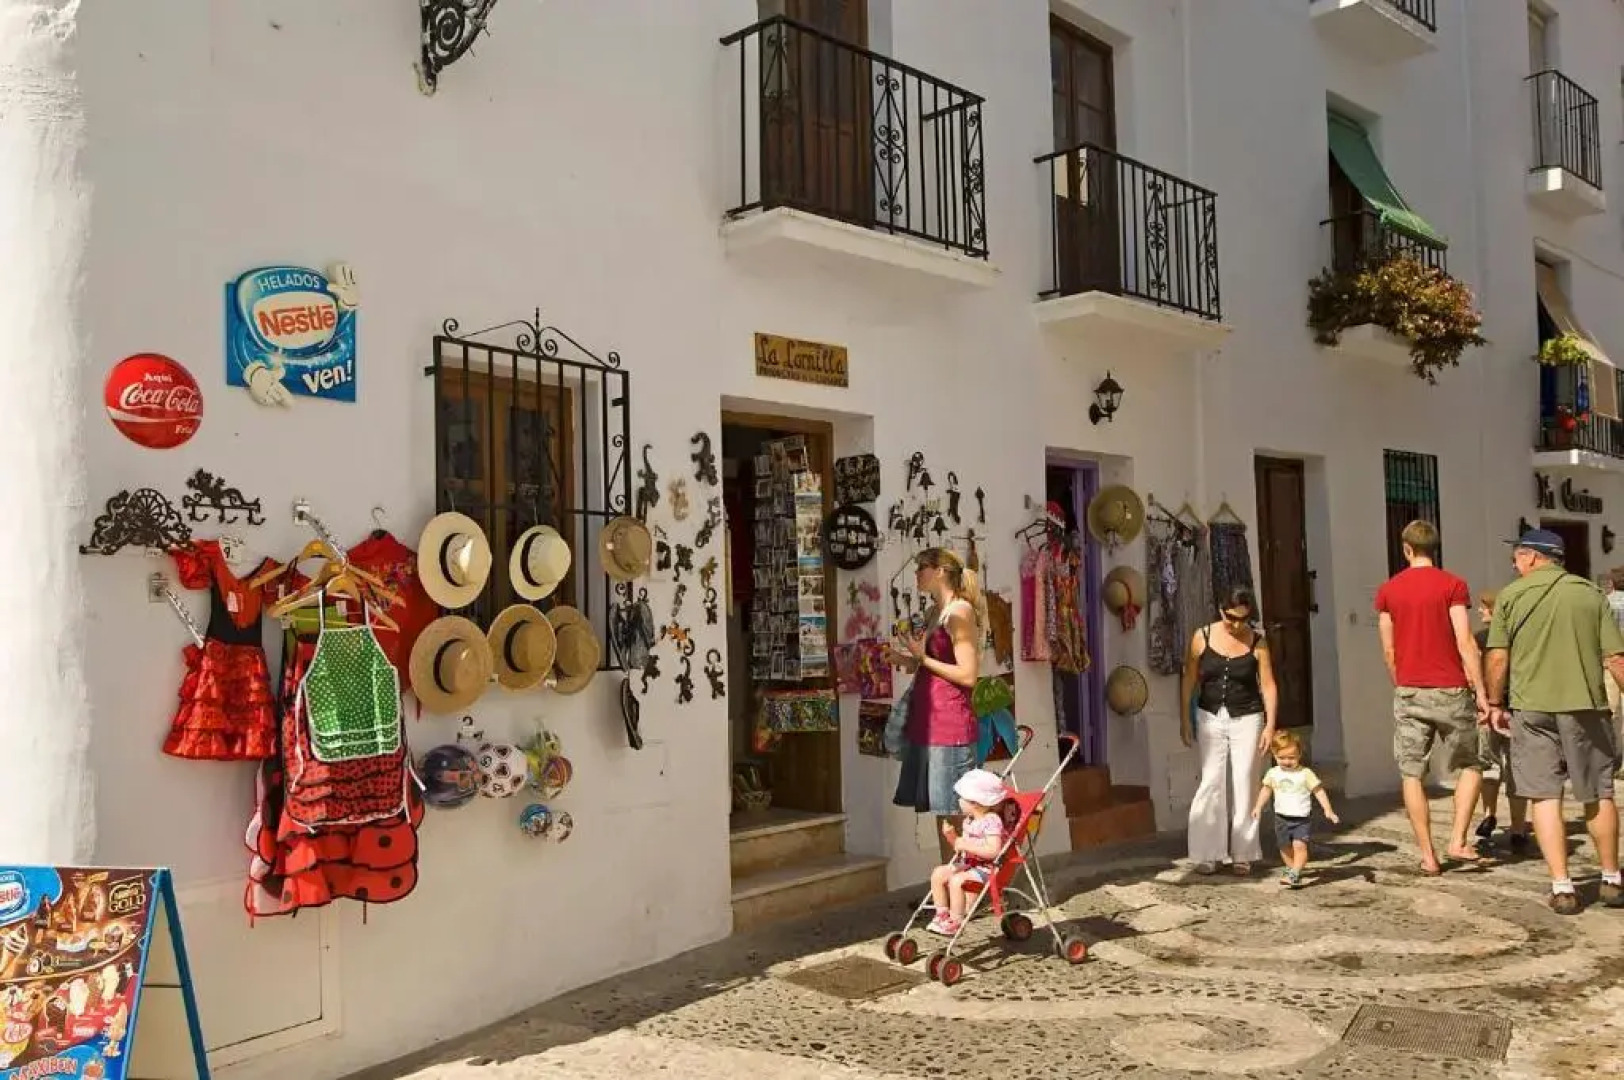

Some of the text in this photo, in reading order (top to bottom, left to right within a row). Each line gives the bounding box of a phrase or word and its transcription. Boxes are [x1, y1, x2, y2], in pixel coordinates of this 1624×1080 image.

[257, 273, 321, 293] HELADOS
[257, 304, 336, 337] Nestlé
[302, 360, 353, 394] ven!
[110, 894, 147, 913] GOLD
